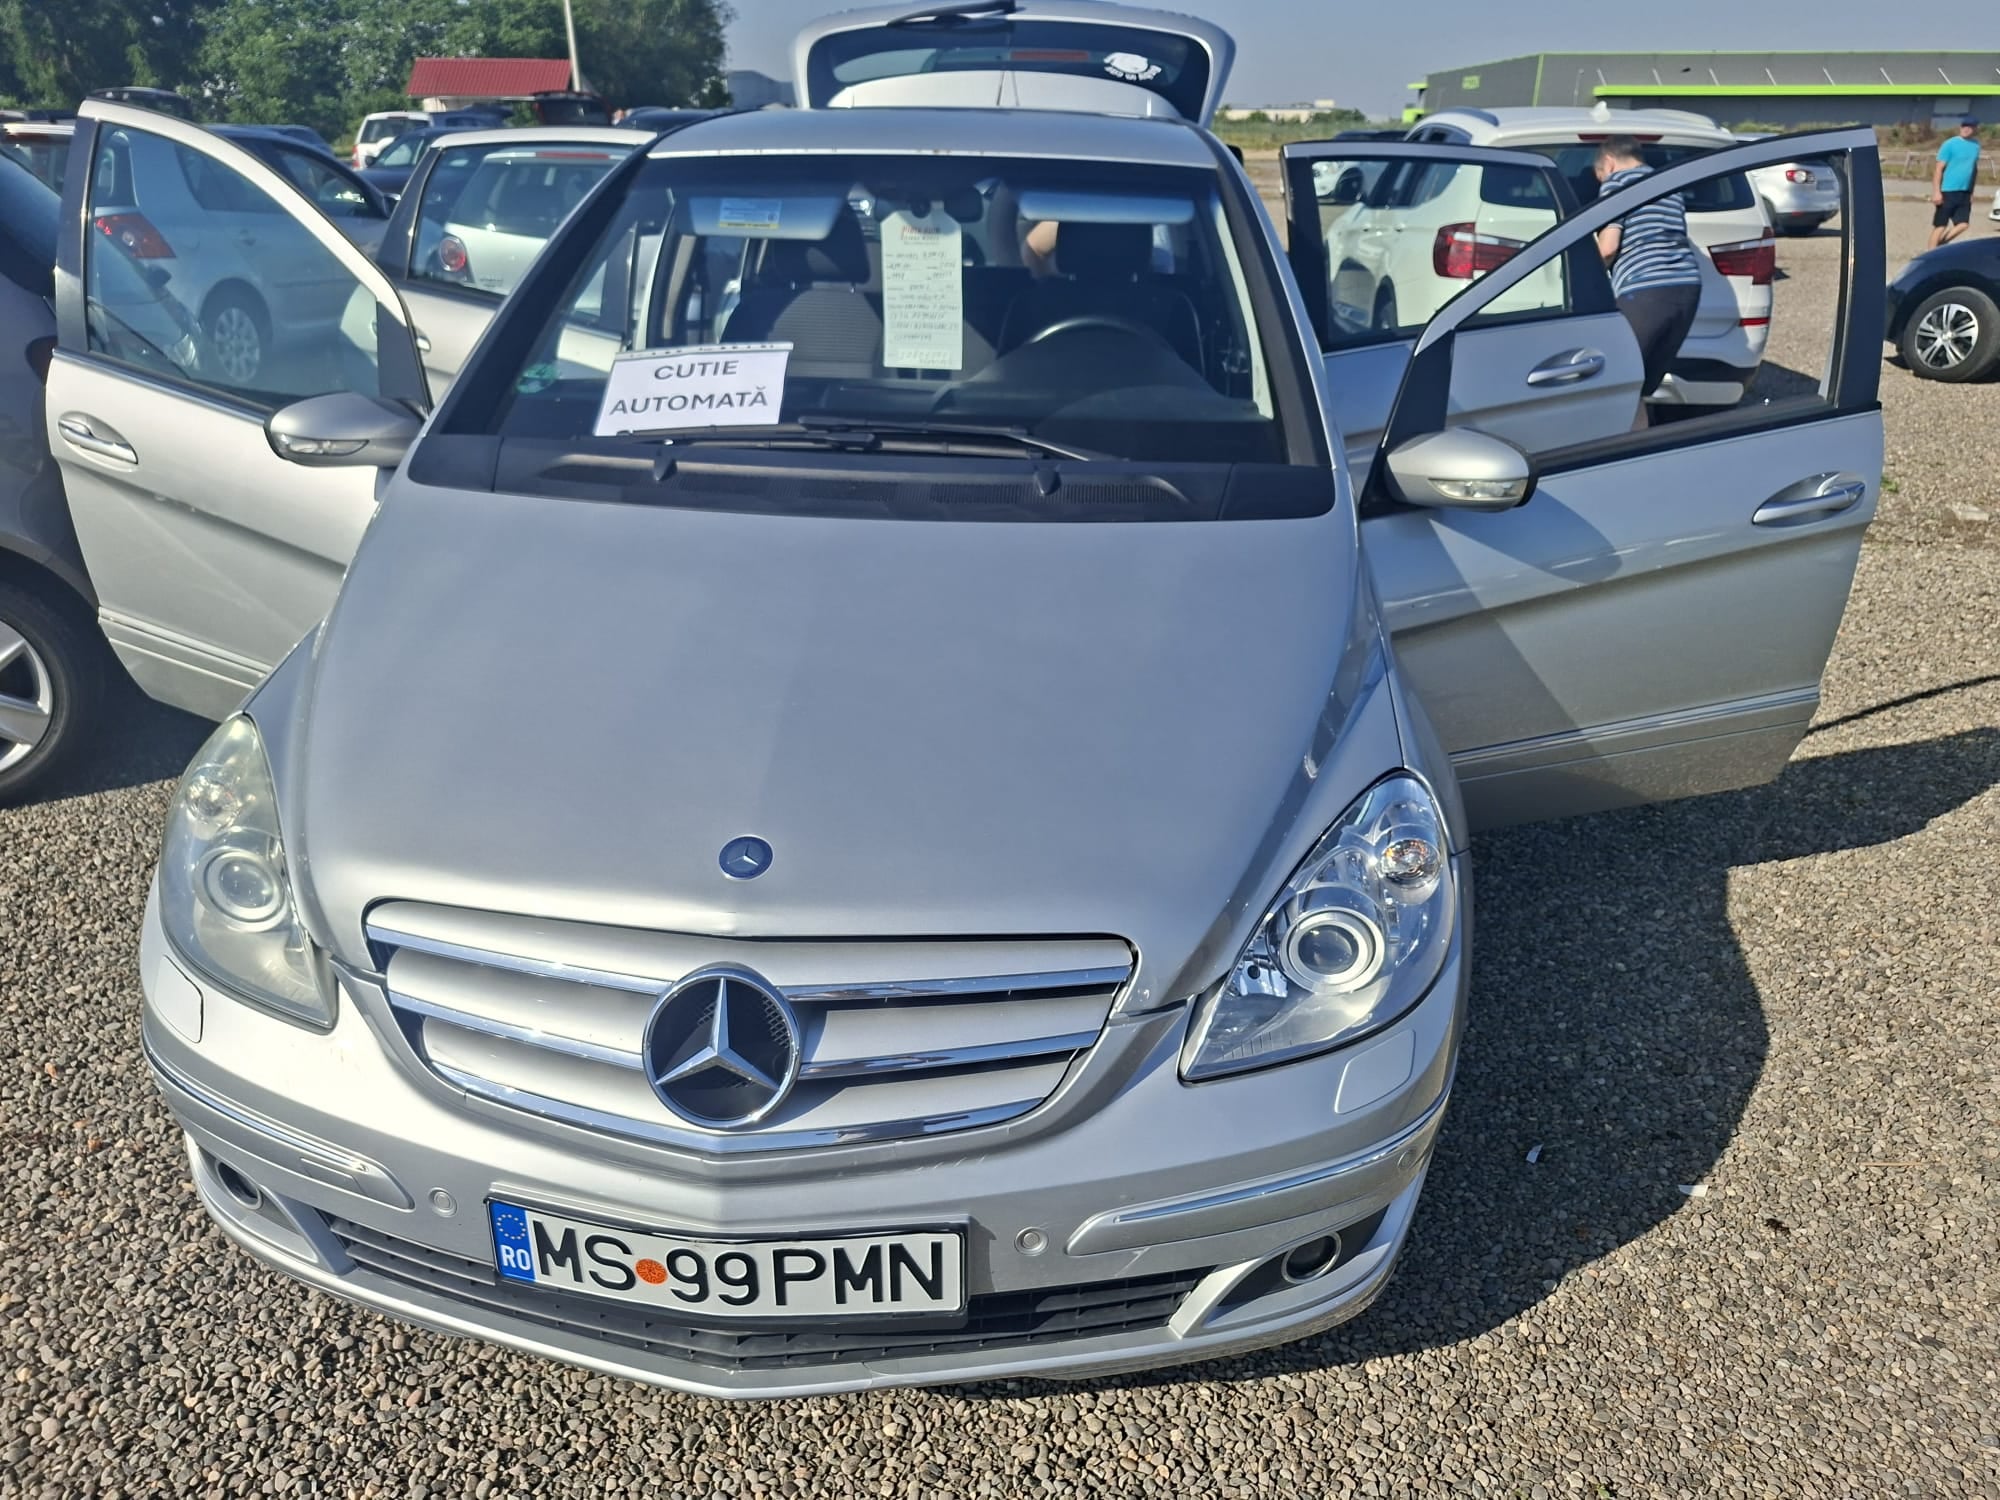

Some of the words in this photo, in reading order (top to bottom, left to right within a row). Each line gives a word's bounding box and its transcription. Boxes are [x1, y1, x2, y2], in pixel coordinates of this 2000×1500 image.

[654, 360, 739, 380] CUTIE
[609, 385, 768, 416] AUTOMATĂ
[501, 1245, 531, 1271] RO
[533, 1220, 636, 1290] MS
[666, 1248, 760, 1306] 99
[773, 1241, 943, 1306] PMN
